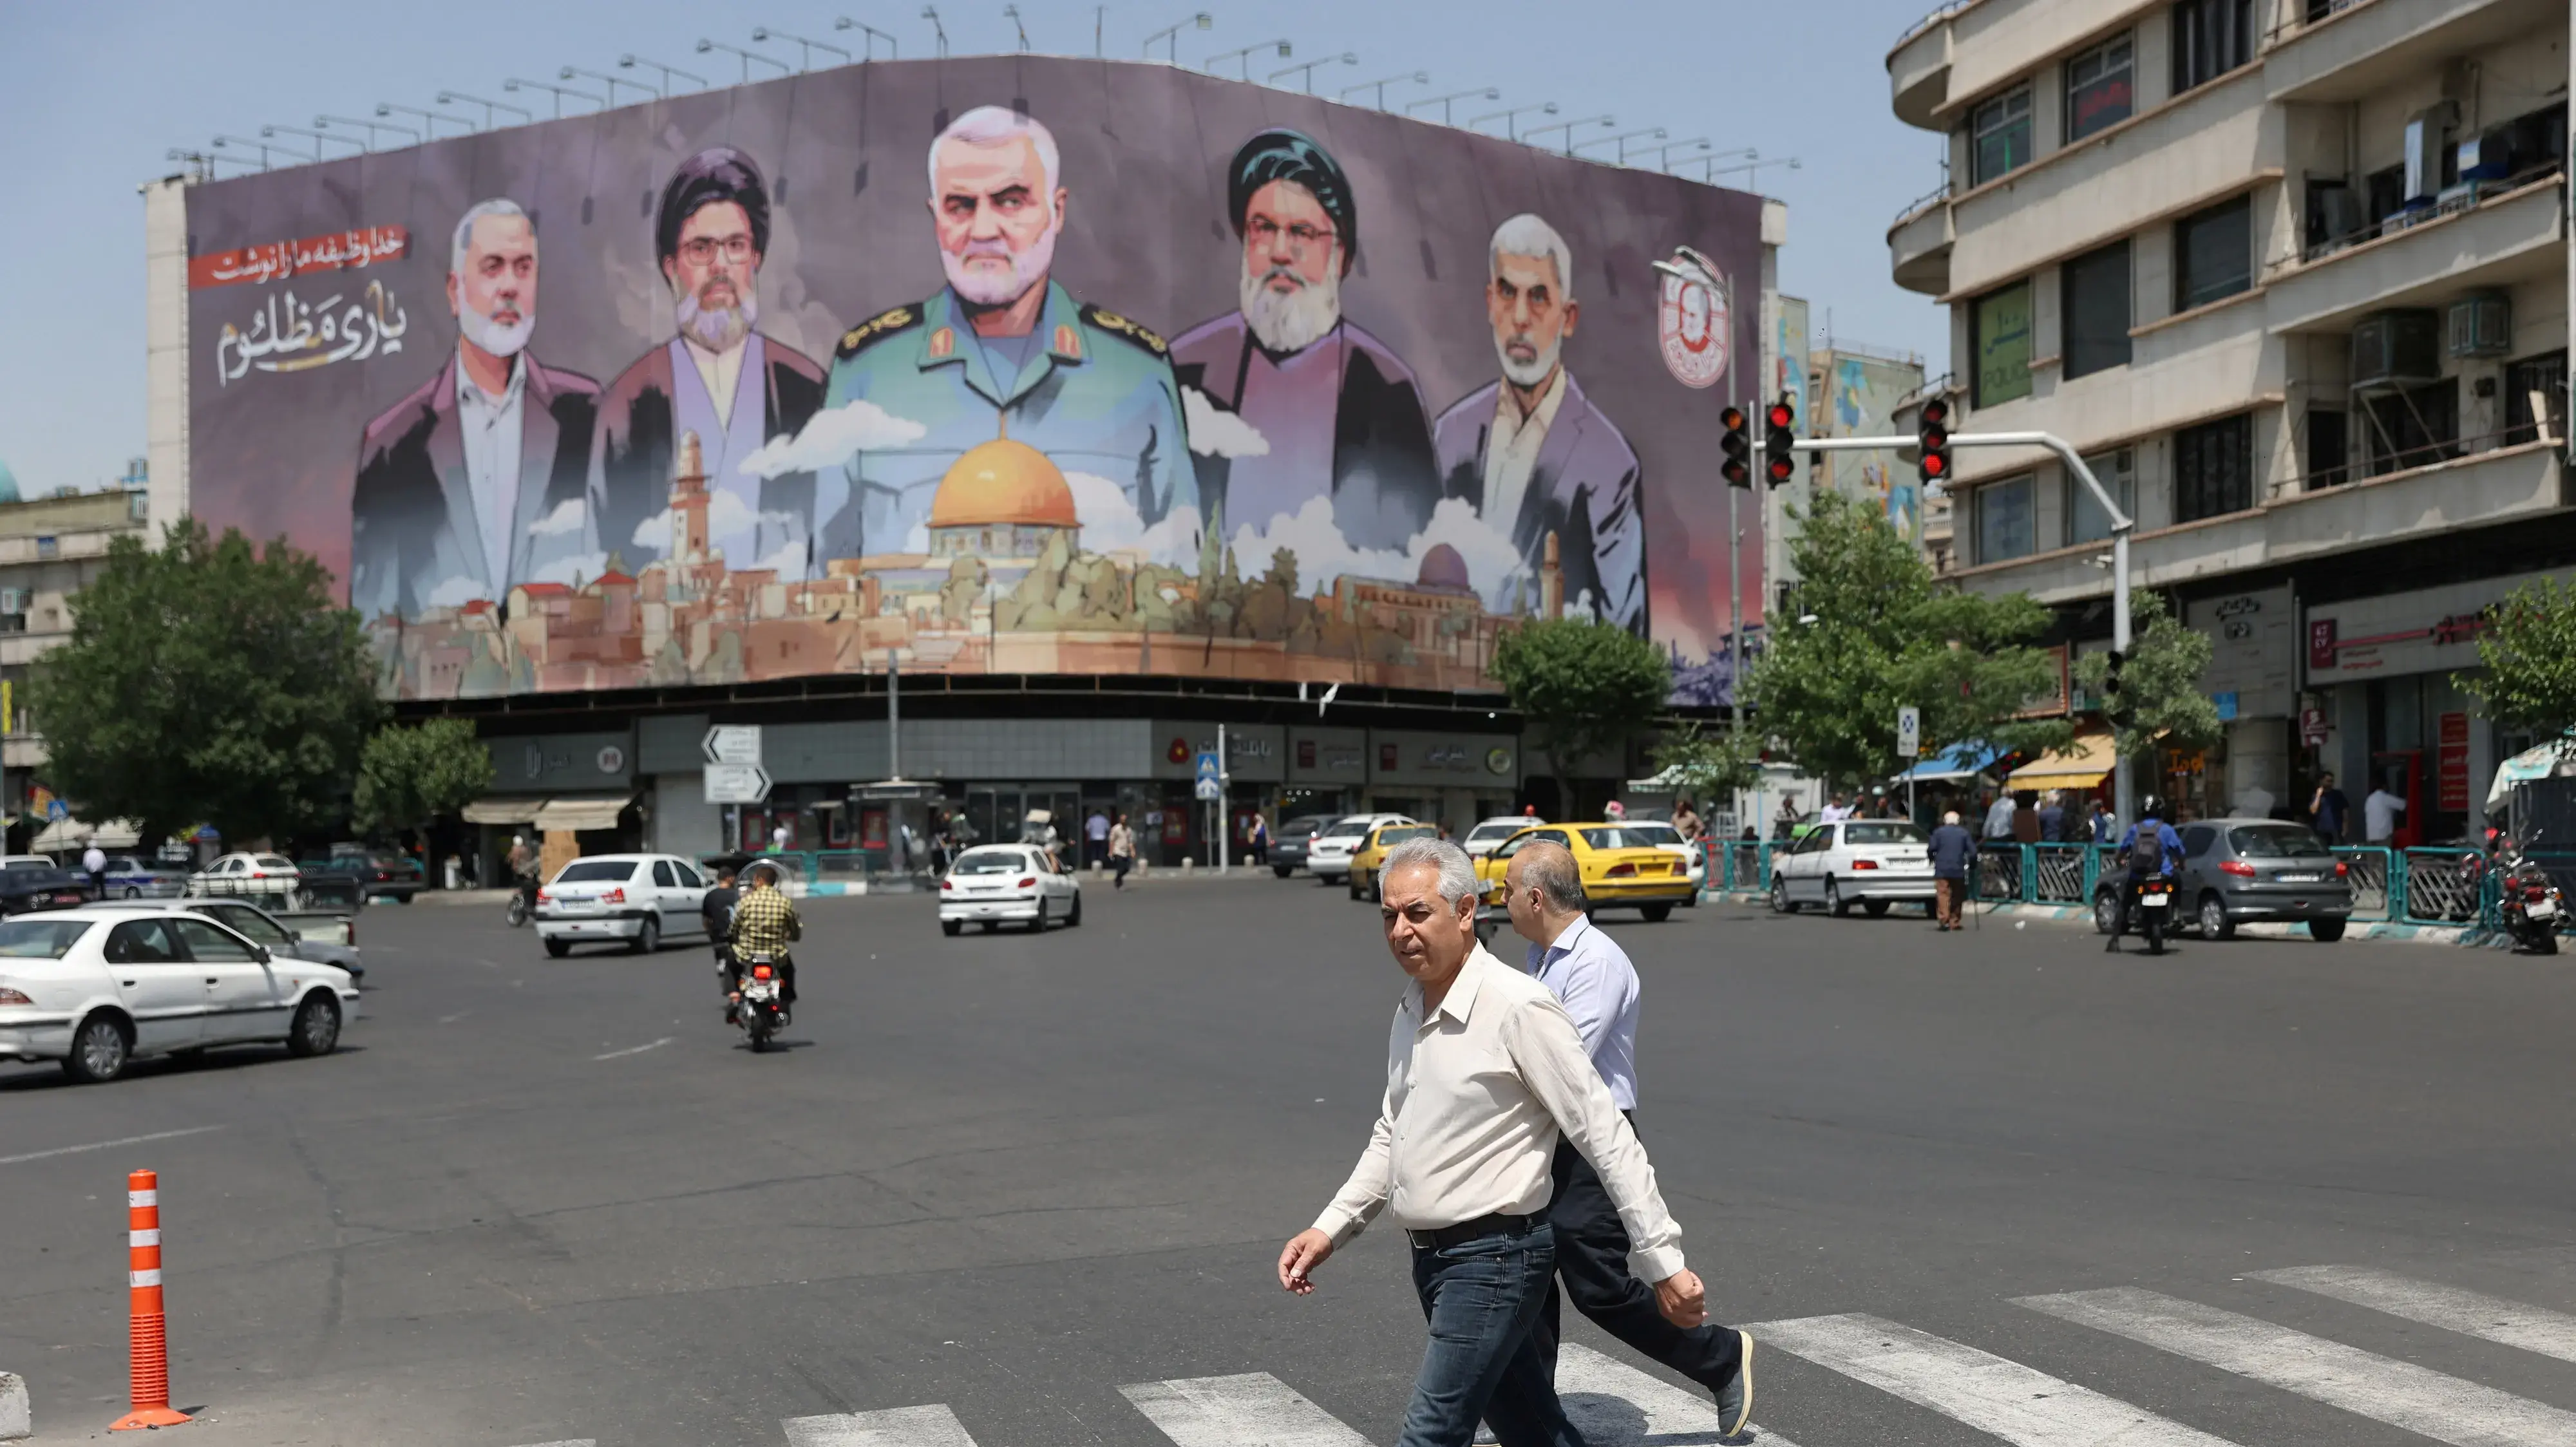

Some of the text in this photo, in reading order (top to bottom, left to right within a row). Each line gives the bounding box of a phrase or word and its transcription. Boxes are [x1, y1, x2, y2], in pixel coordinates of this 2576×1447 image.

[313, 231, 370, 269] وظیفه
[372, 225, 404, 256] خدا
[212, 247, 278, 284] نوشت
